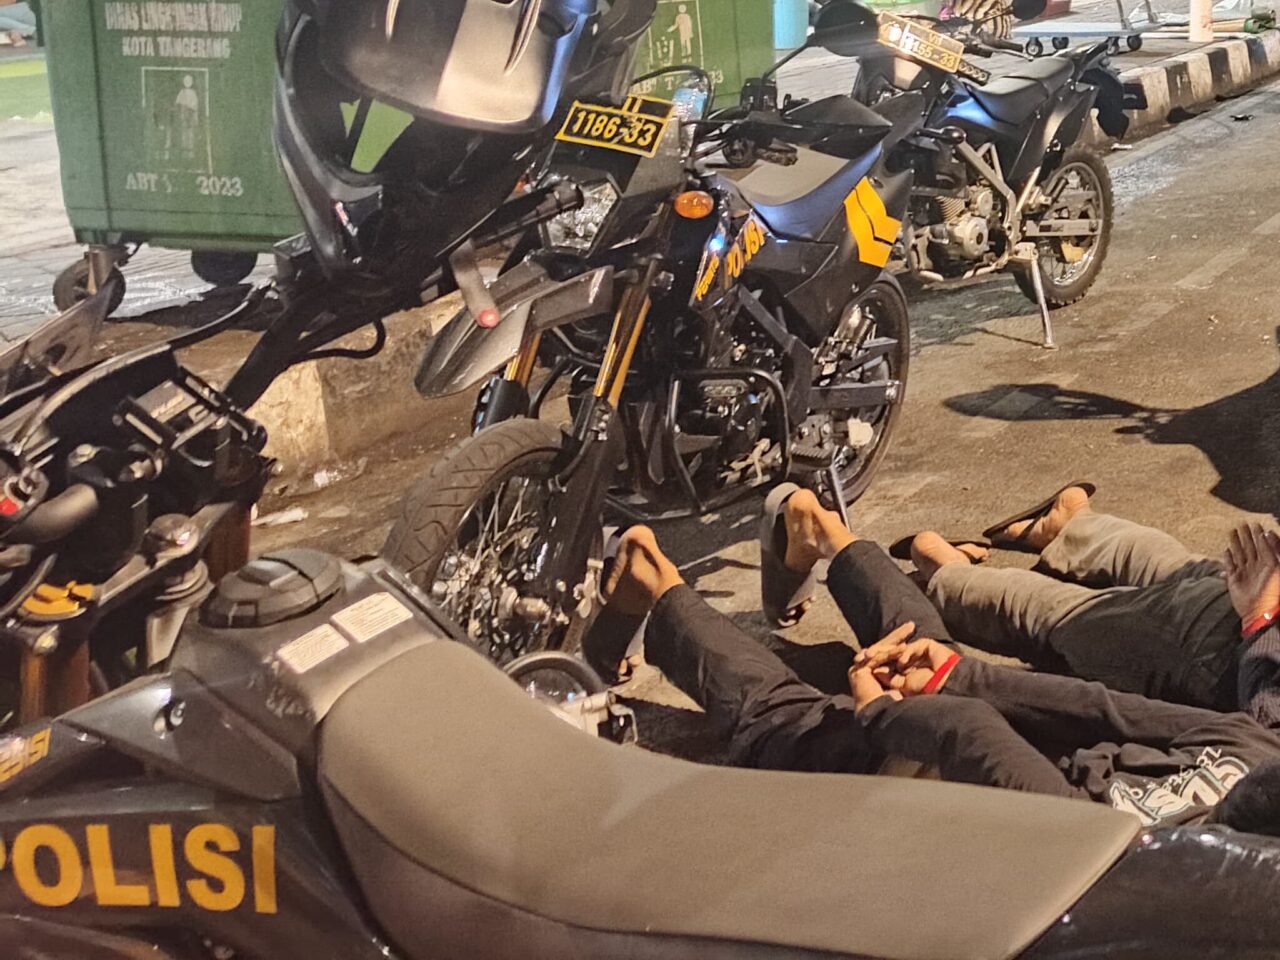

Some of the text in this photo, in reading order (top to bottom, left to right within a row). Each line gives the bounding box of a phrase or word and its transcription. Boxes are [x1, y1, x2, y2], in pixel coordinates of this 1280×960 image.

[122, 37, 231, 58] KOTA TANGERANG
[572, 110, 657, 147] 1186-33
[196, 175, 243, 196] 2023
[0, 823, 277, 914] OLISI
